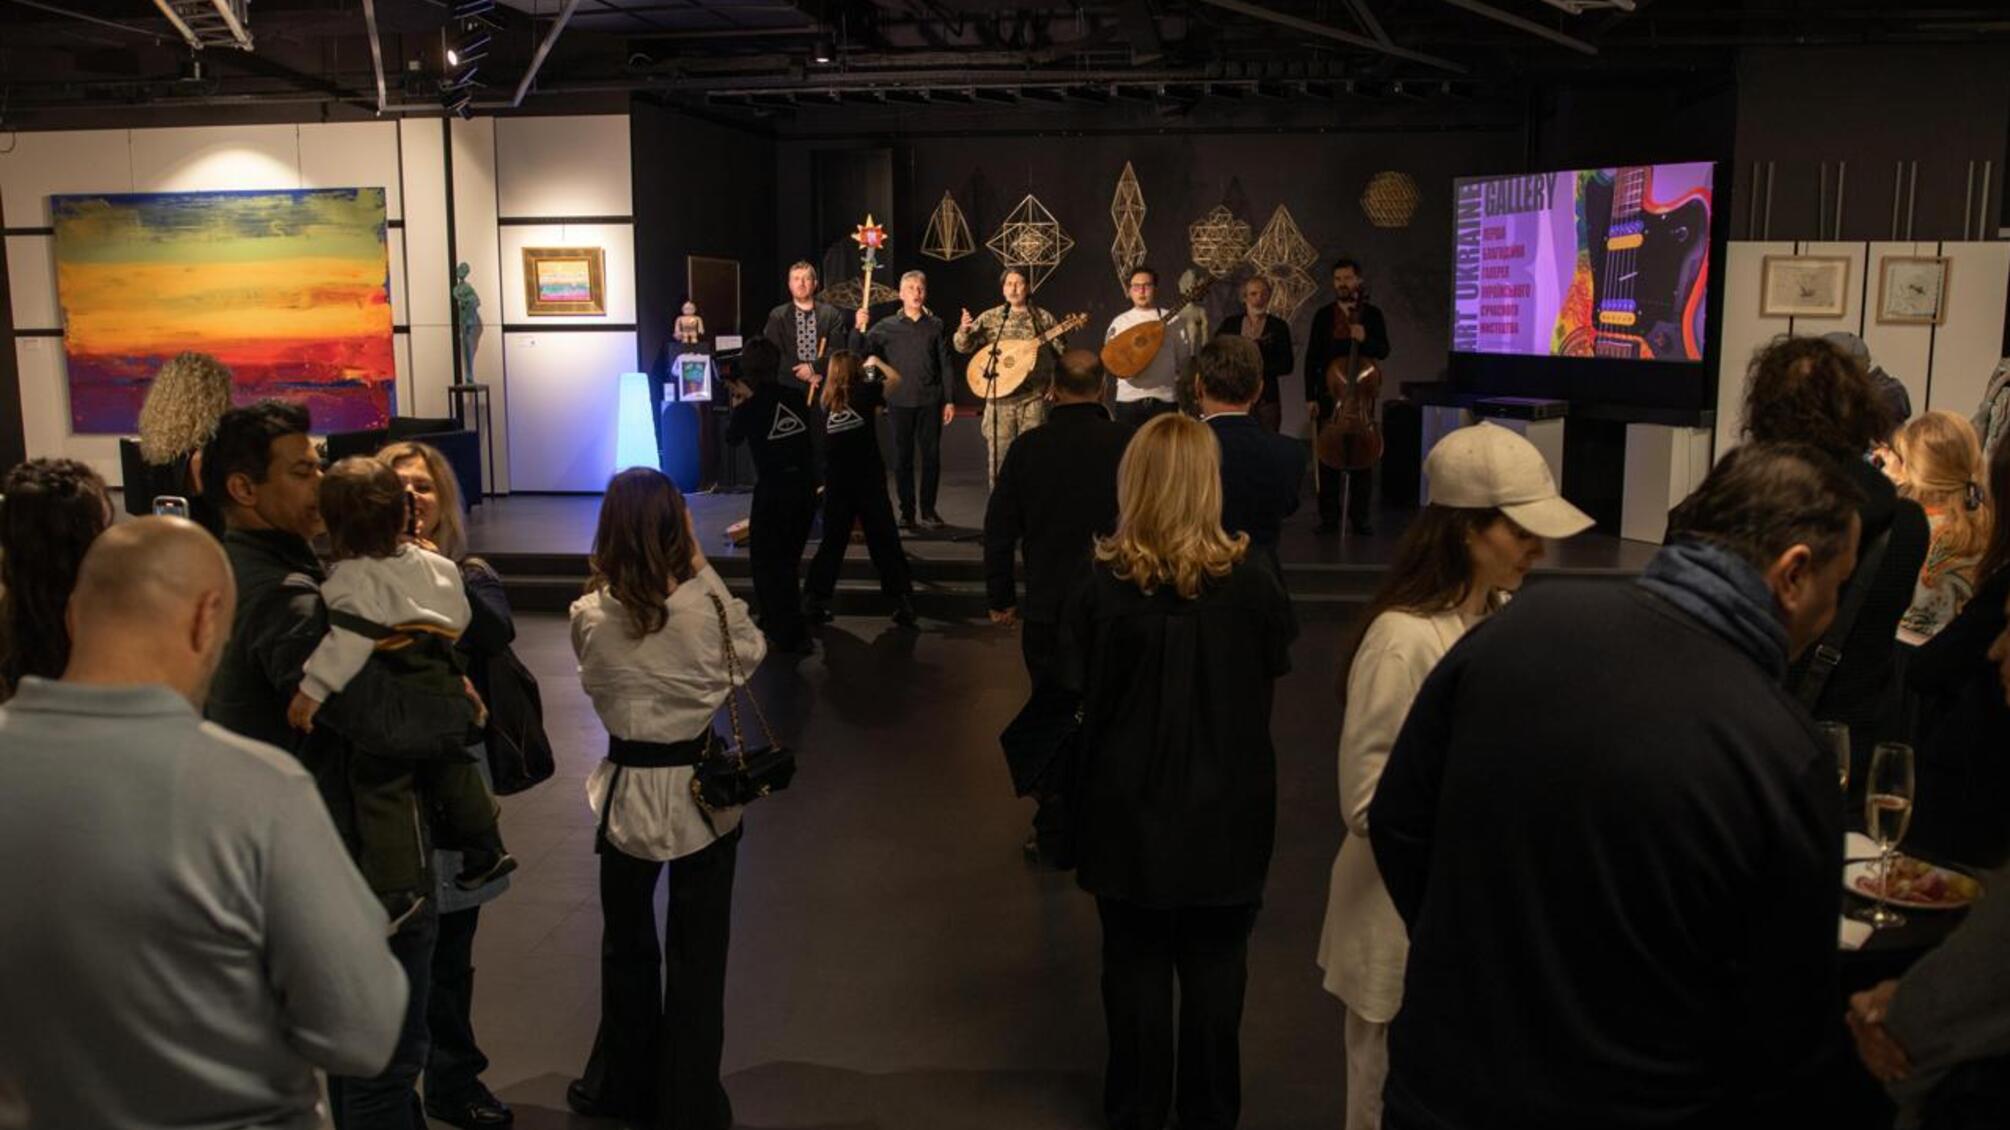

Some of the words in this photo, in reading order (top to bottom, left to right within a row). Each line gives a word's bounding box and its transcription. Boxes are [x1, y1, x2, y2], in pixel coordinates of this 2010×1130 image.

[1485, 173, 1557, 217] GALLERY
[1457, 184, 1481, 300] UKRAINE
[1455, 310, 1478, 351] ART
